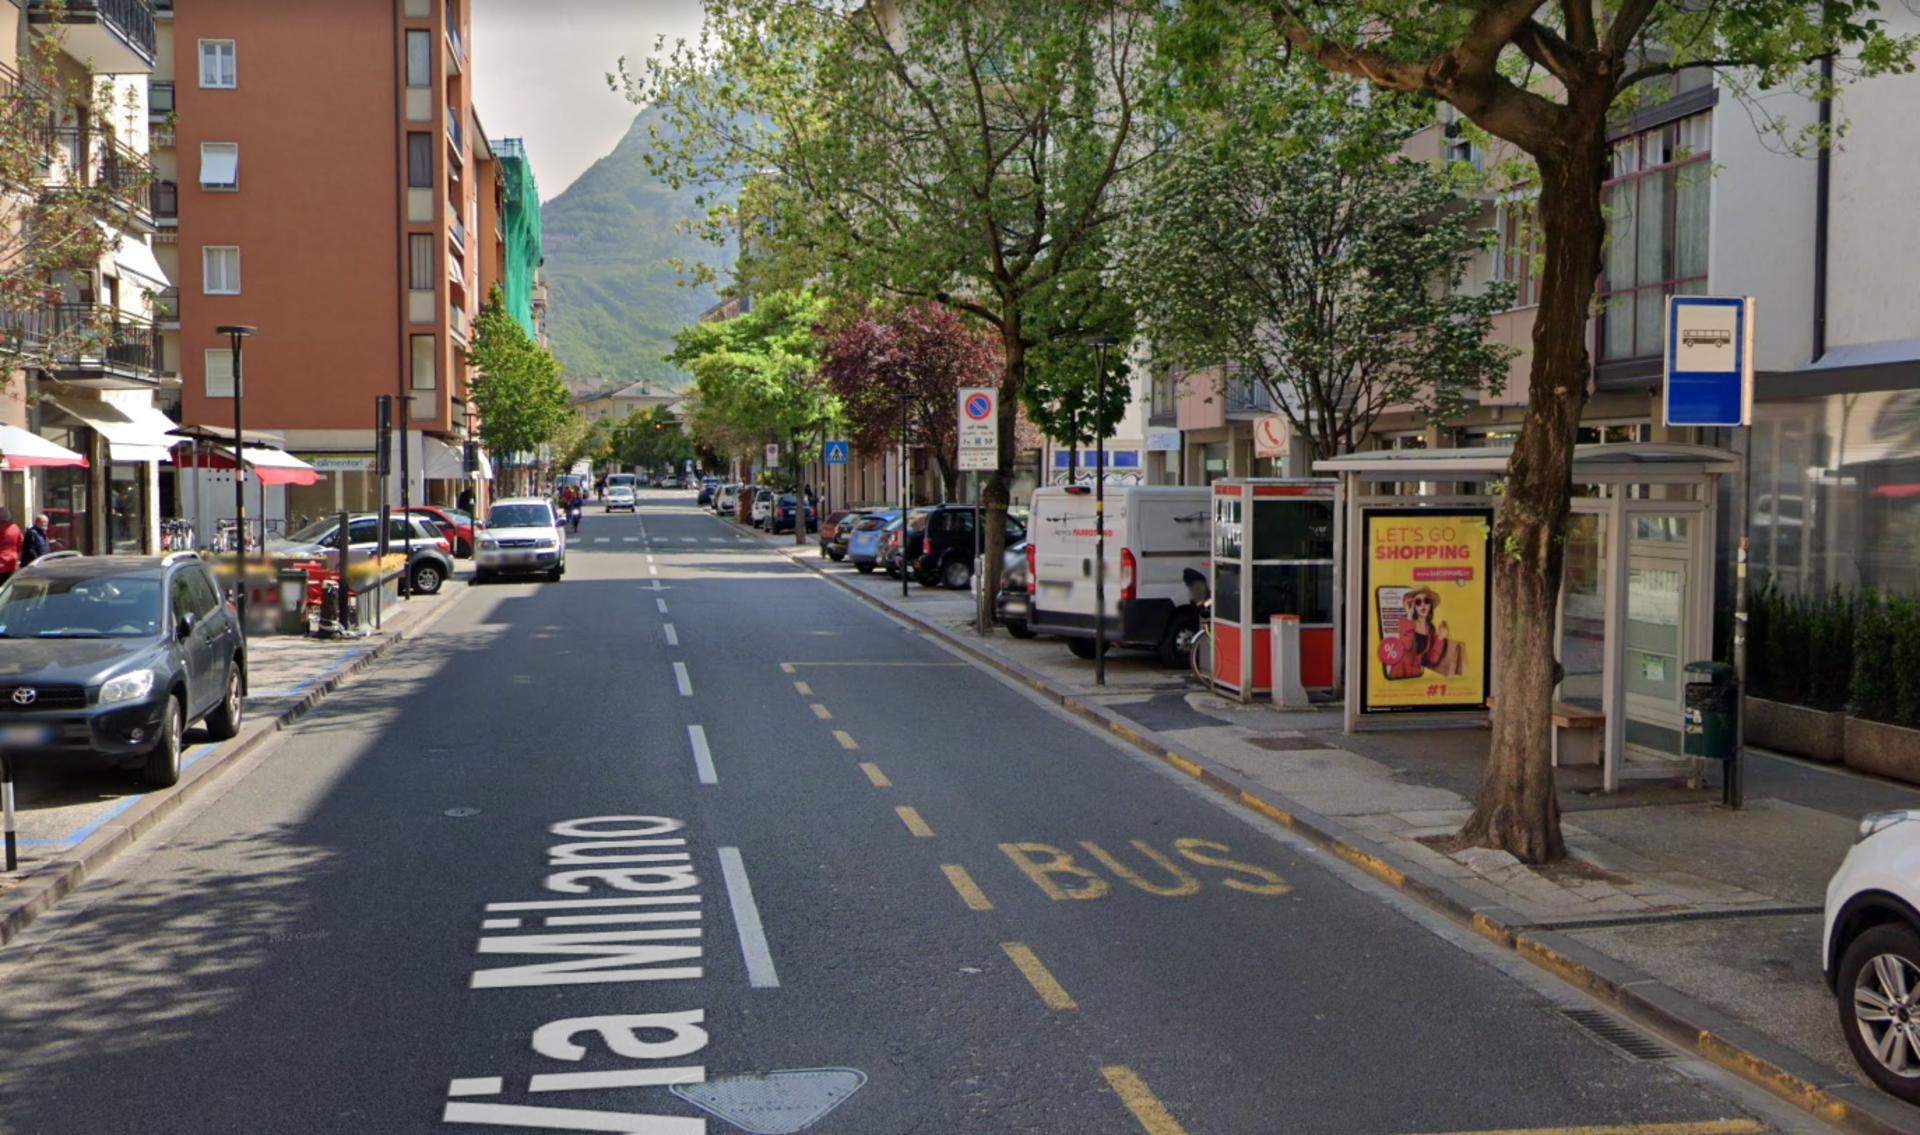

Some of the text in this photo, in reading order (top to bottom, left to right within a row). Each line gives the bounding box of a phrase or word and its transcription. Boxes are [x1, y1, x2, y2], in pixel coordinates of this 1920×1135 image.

[1375, 527, 1456, 543] LET'S GO
[1374, 545, 1470, 560] SHOPPING
[1384, 643, 1398, 658] %
[1426, 684, 1447, 697] #1
[998, 838, 1294, 901] BUS
[471, 815, 703, 989] Milano
